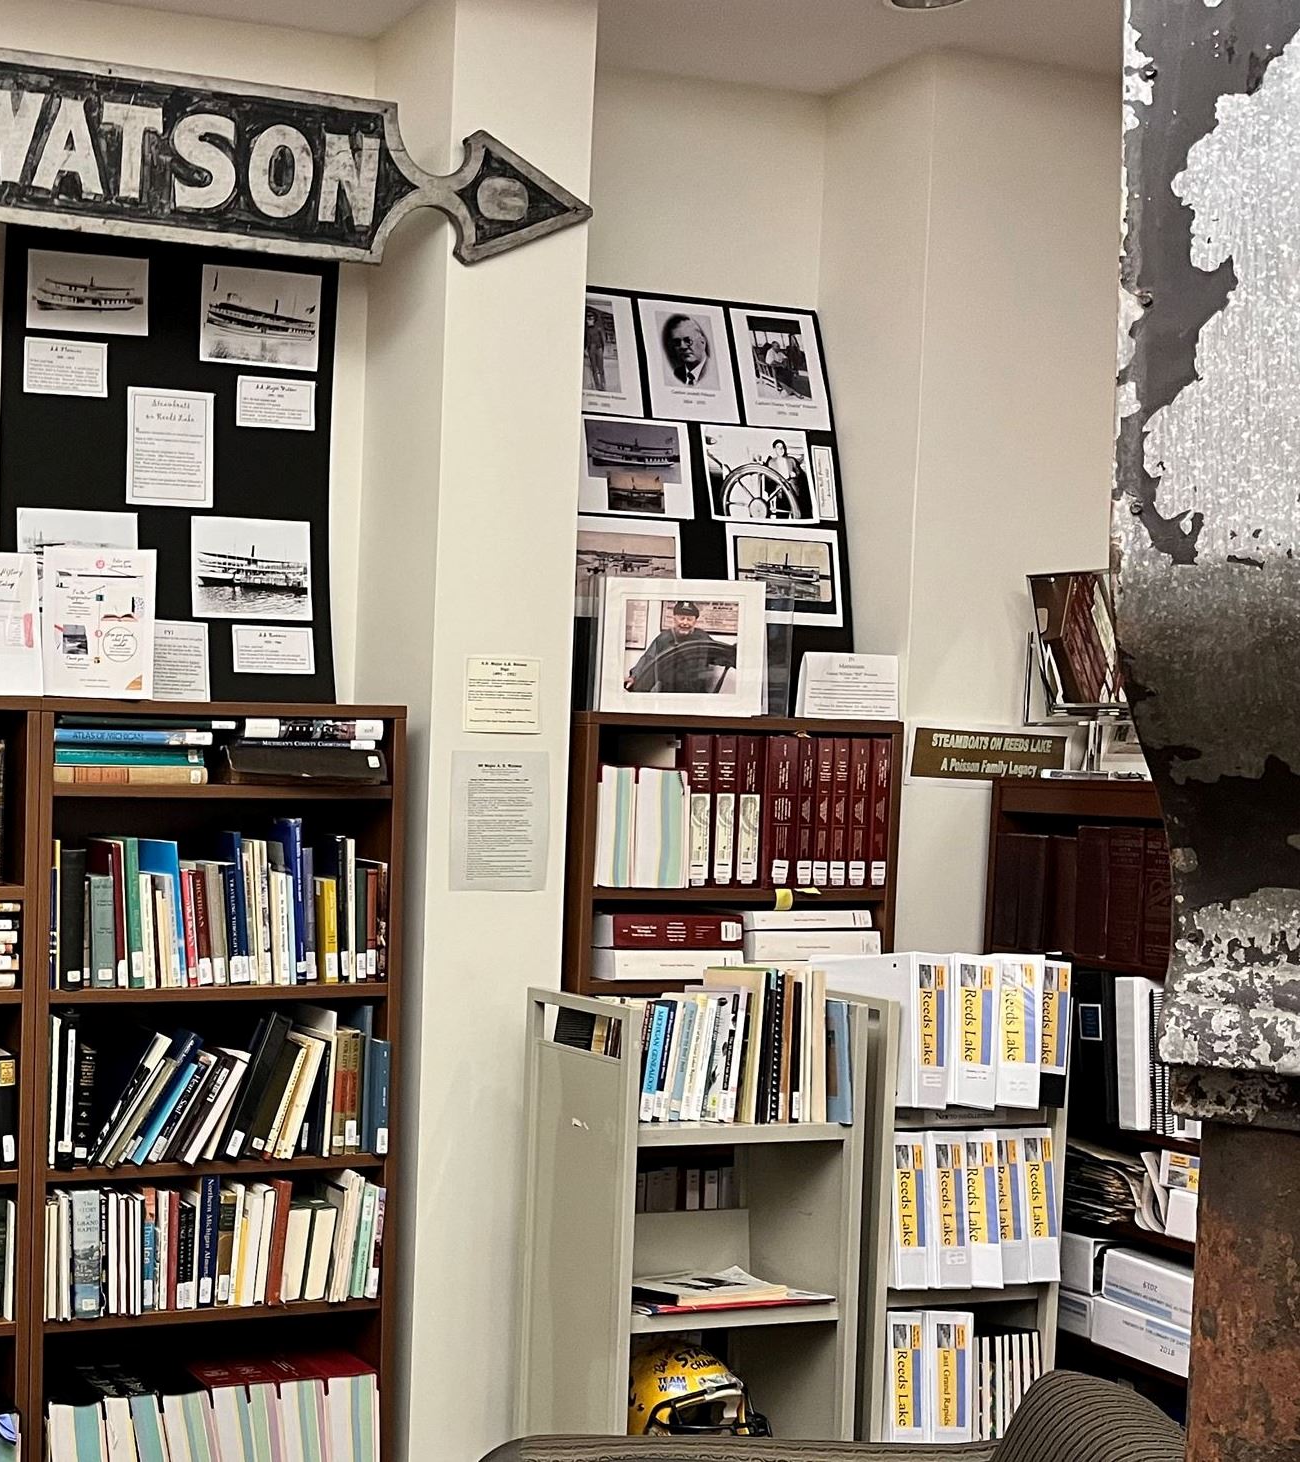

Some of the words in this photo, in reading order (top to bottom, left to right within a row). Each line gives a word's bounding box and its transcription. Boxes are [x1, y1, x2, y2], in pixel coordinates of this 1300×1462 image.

[72, 732, 95, 740] ATLAS
[106, 732, 144, 741] MICHIGAN
[931, 732, 990, 751] STEAMBOATS
[990, 735, 1001, 751] ON
[1002, 736, 1030, 752] REEDS
[1030, 738, 1053, 754] LAKE
[940, 757, 948, 772] A
[949, 757, 980, 774] Poisson
[980, 759, 1008, 776] Family
[1008, 760, 1038, 778] Legacy
[922, 990, 933, 1029] Reeds
[964, 989, 977, 1027] Reeds
[1005, 989, 1017, 1027] Reeds
[1042, 991, 1054, 1030] Reeds
[923, 1033, 933, 1065] Lake
[964, 1030, 976, 1062] Lake
[1006, 1030, 1020, 1061] Lake
[1041, 1033, 1053, 1065] Lake
[207, 1178, 215, 1213] Northern
[899, 1170, 911, 1210] Reeds
[940, 1170, 952, 1209] Reeds
[966, 1167, 980, 1207] Reeds
[1029, 1163, 1041, 1201] Reeds
[205, 1214, 213, 1250] Michigan
[902, 1214, 912, 1247] Lake
[942, 1212, 953, 1246] Lake
[968, 1211, 981, 1242] Lake
[1032, 1205, 1043, 1237] Lake
[1142, 1279, 1158, 1292] 2019
[942, 1350, 951, 1364] East
[1159, 1345, 1175, 1356] 2018
[897, 1350, 909, 1391] Reeds
[943, 1365, 951, 1397] Grand
[658, 1384, 688, 1392] WORK
[898, 1394, 909, 1427] Lake
[941, 1399, 952, 1427] Rapids
